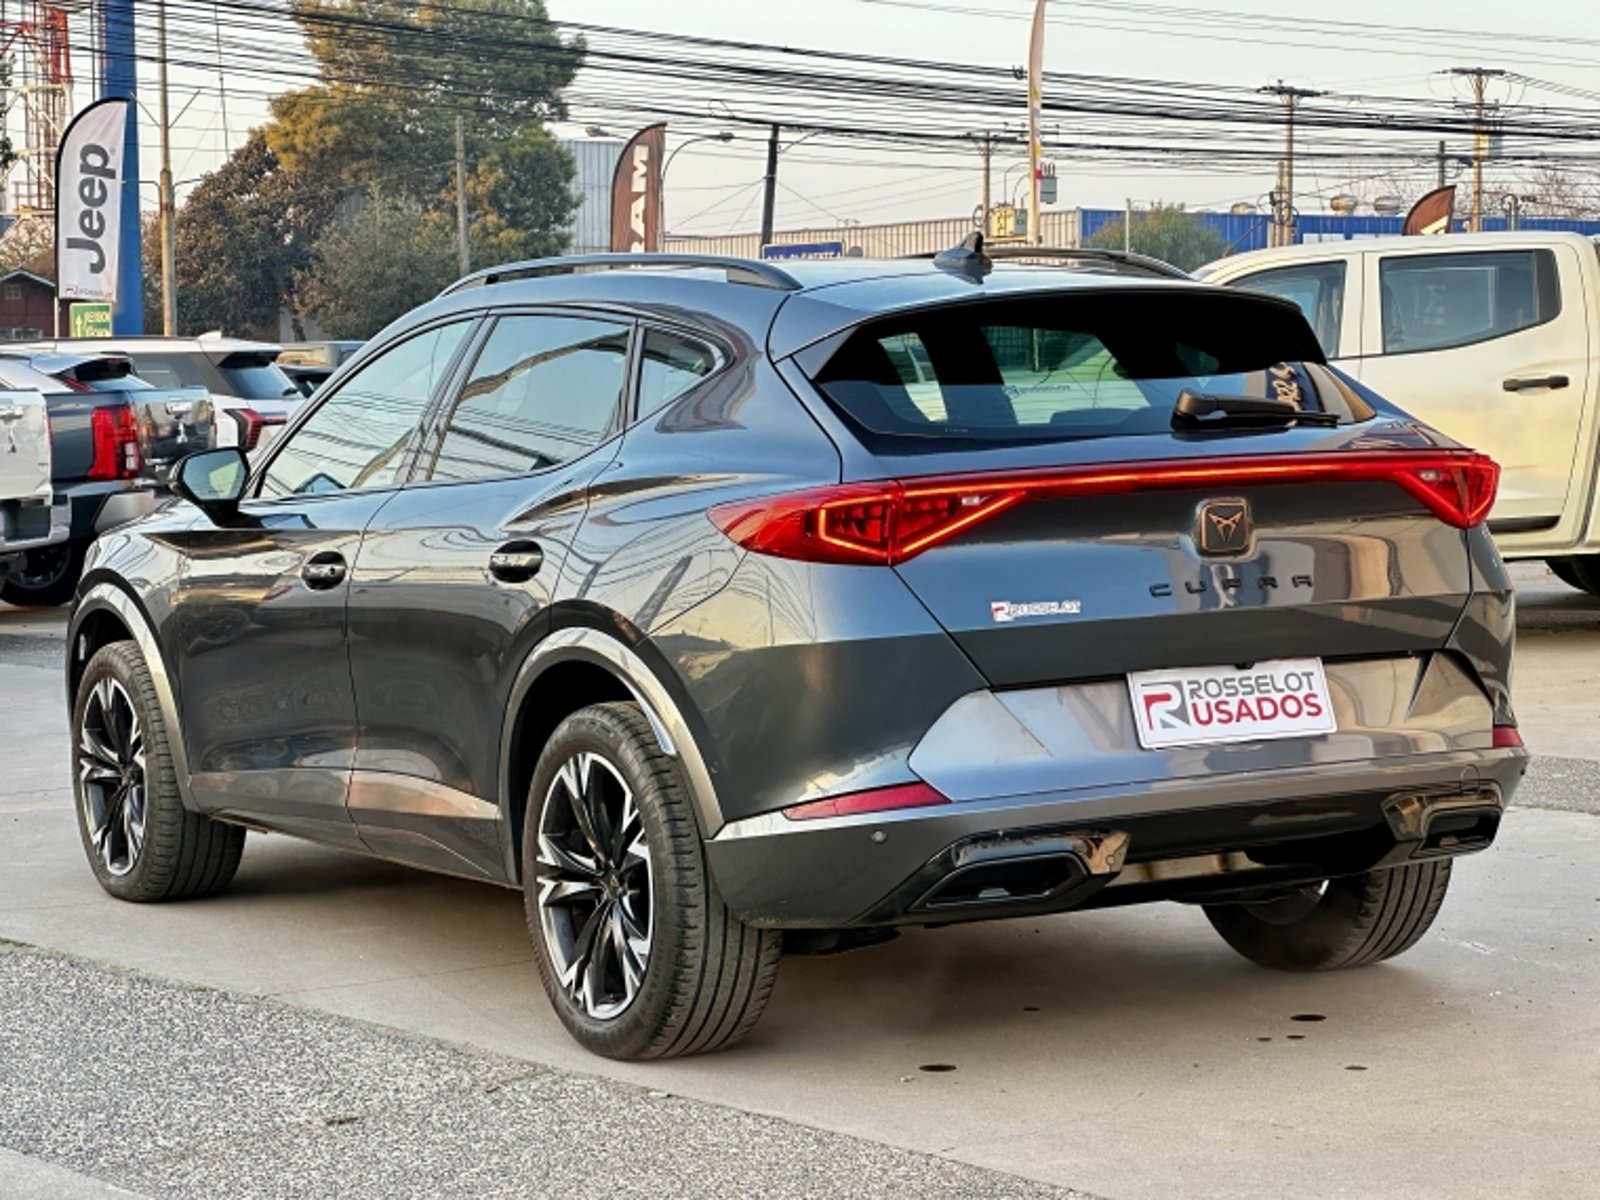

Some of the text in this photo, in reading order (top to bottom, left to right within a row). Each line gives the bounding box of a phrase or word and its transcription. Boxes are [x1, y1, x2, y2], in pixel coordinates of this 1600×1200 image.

[66, 143, 116, 274] Jeep
[1149, 575, 1314, 598] CUPRA
[1187, 672, 1315, 699] ROSSELOT
[1191, 693, 1323, 726] USADOS
